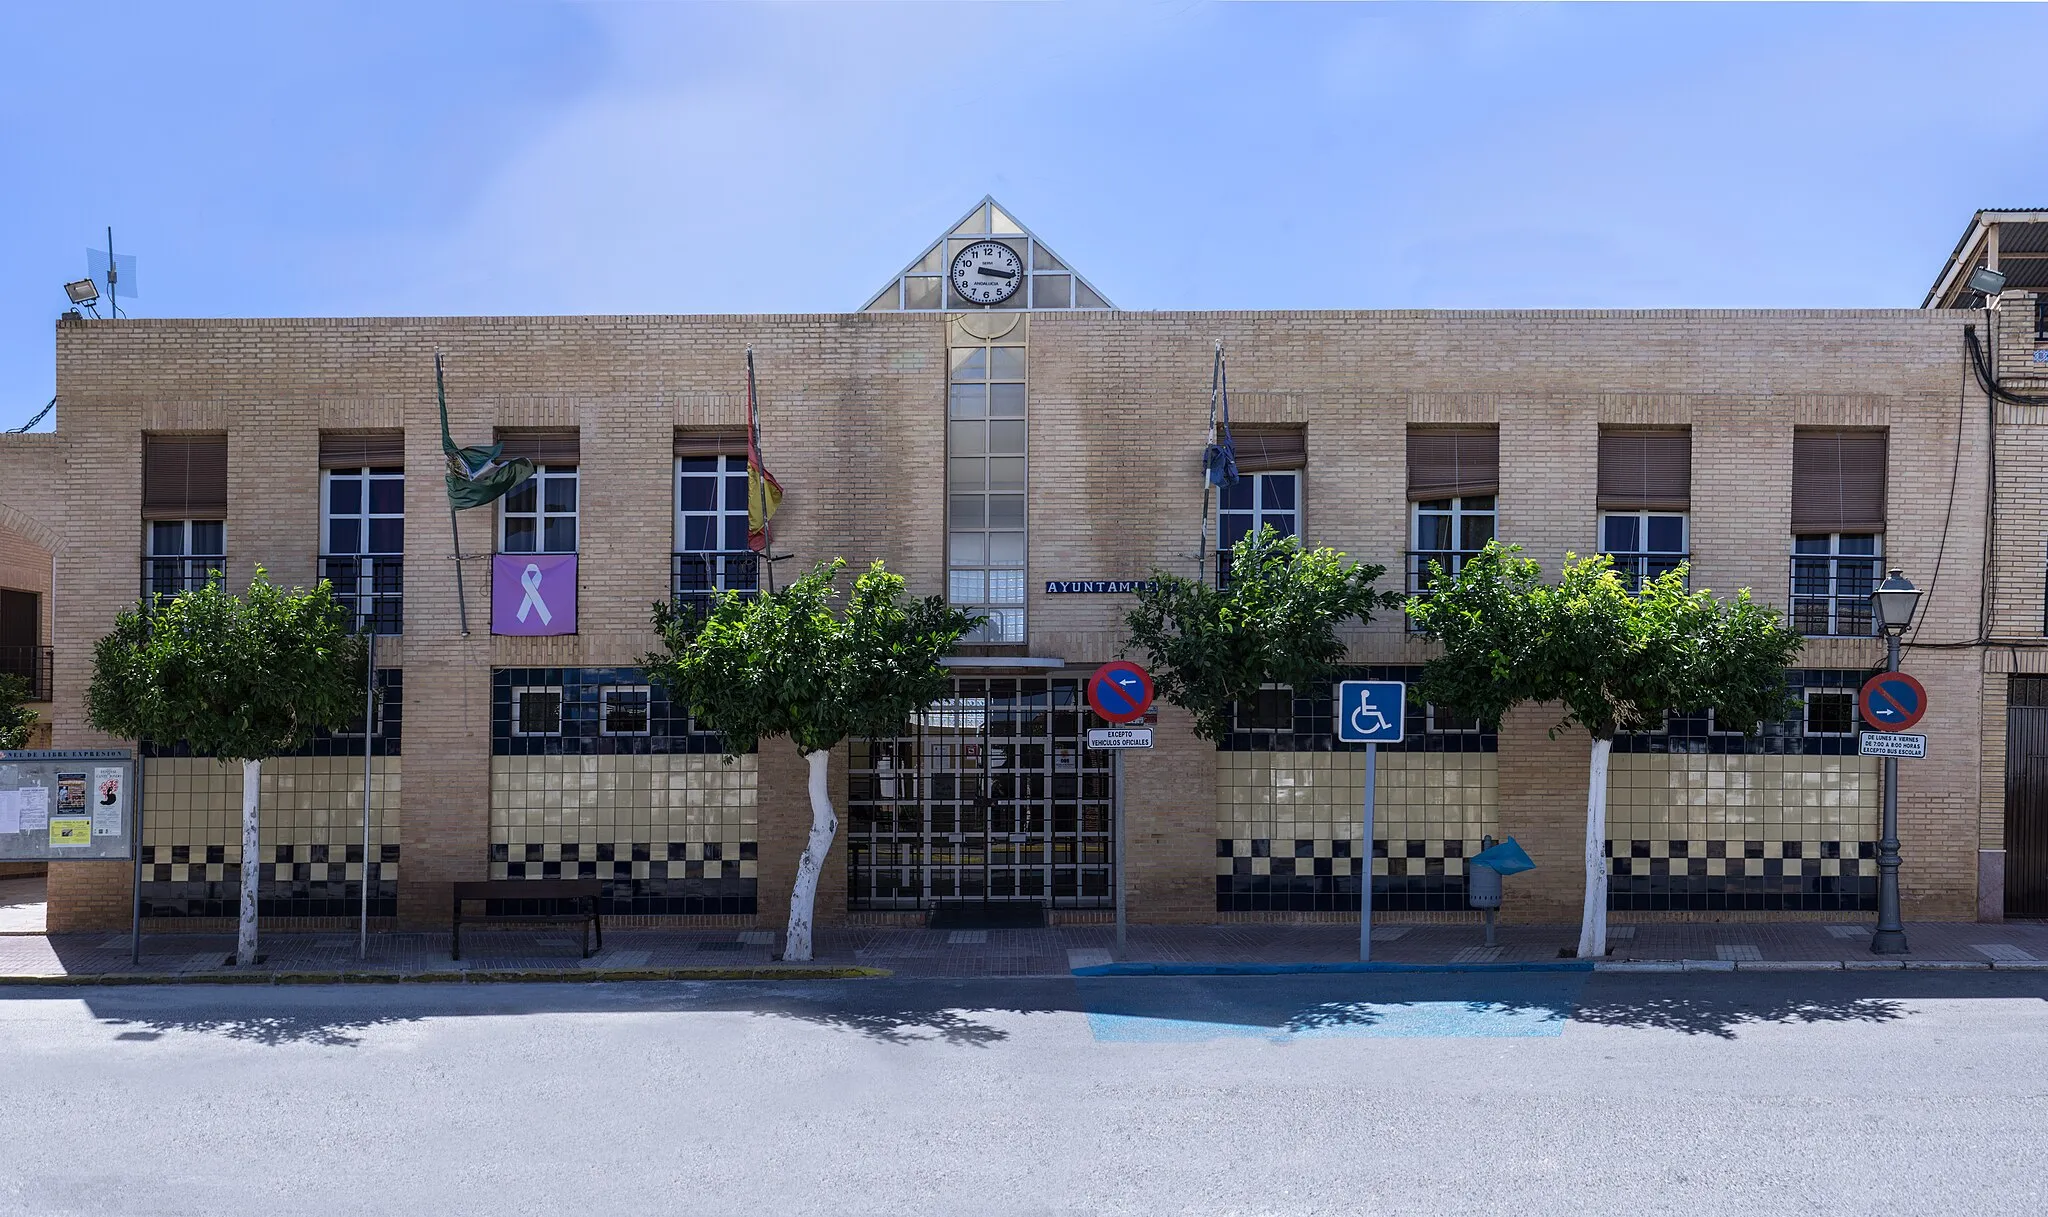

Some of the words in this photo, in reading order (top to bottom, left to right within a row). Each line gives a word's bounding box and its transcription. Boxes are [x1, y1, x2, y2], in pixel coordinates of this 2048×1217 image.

[984, 248, 993, 256] 12
[962, 260, 972, 268] 10
[1007, 258, 1012, 266] 2
[958, 269, 965, 277] 9
[971, 288, 977, 296] 7
[983, 291, 990, 299] 6
[996, 288, 1003, 296] 5
